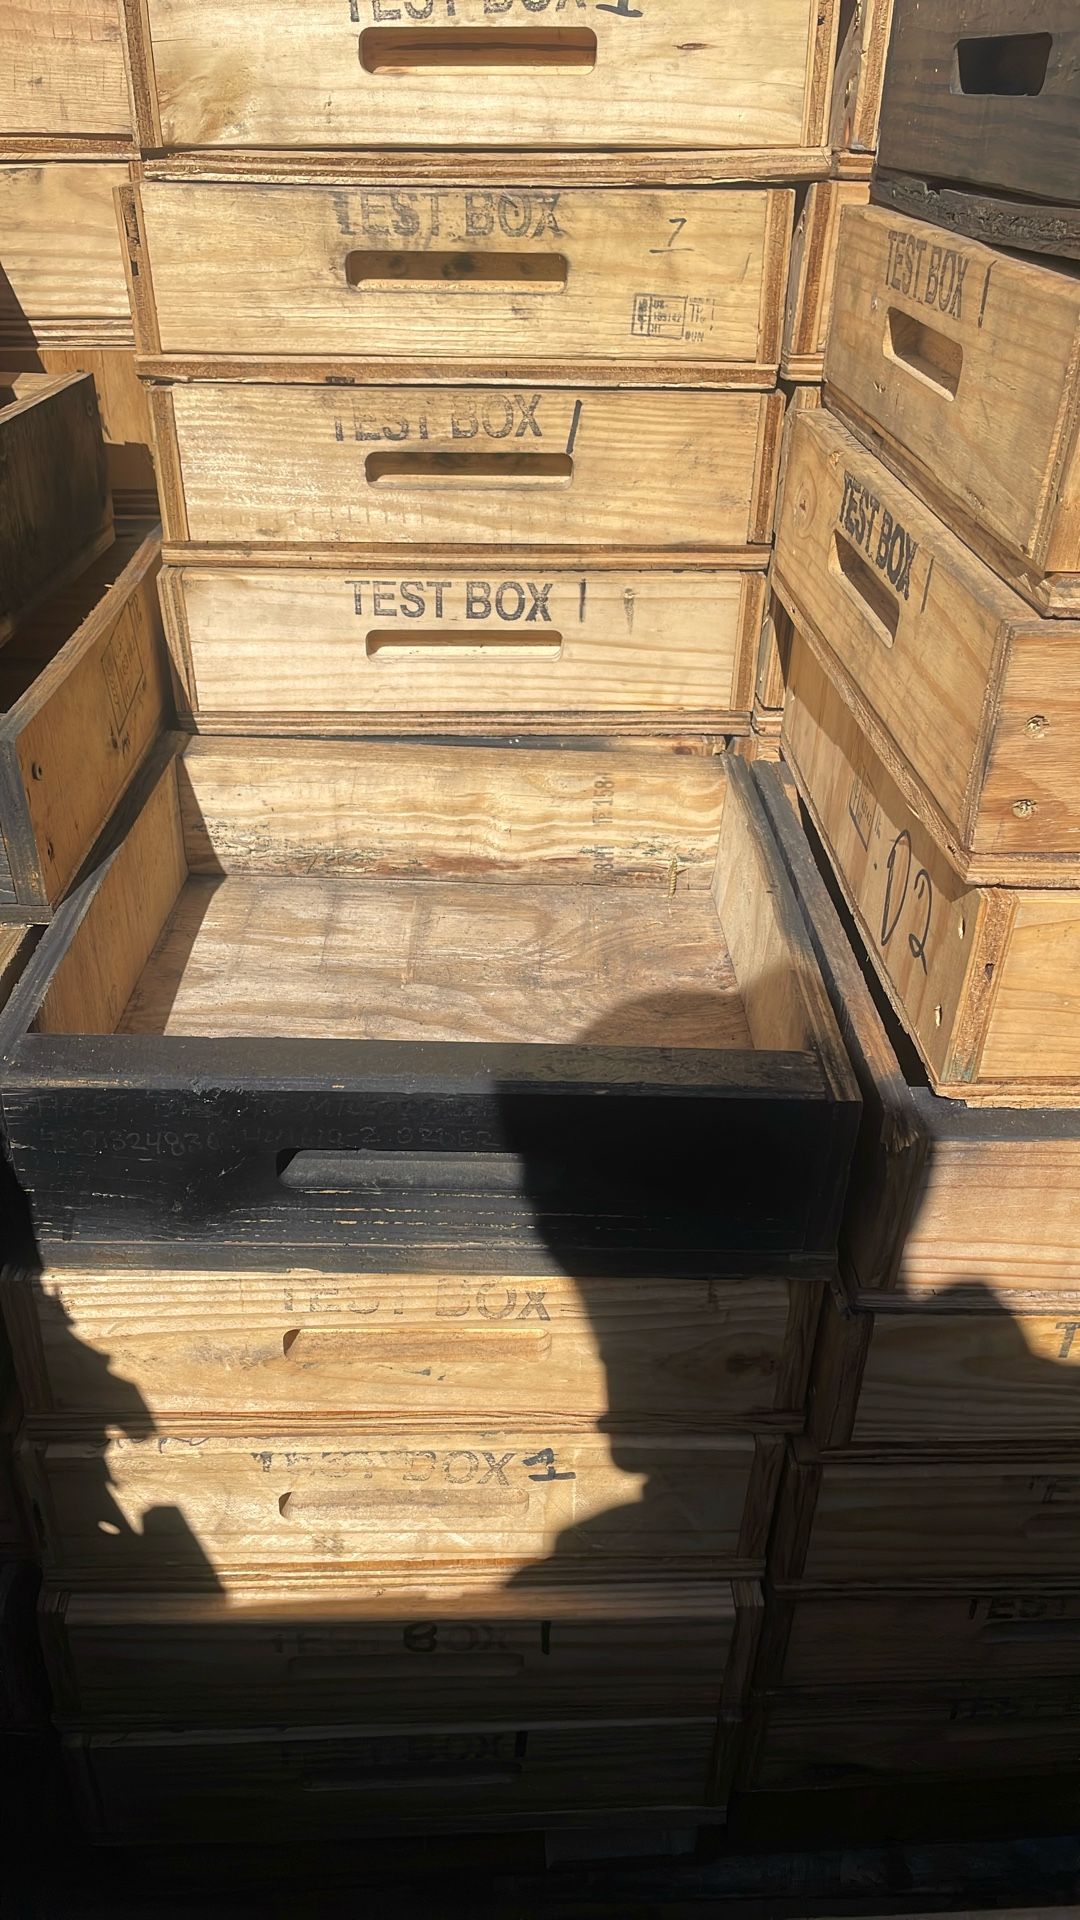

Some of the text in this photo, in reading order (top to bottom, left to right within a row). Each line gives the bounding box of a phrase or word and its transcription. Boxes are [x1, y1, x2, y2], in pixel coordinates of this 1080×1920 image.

[332, 192, 567, 239] TEST BOX
[667, 217, 689, 247] 7
[885, 231, 927, 302] TEST
[925, 246, 970, 320] BOX
[332, 398, 430, 442] TEST
[451, 393, 543, 440] BOX
[839, 468, 881, 562] TEST
[878, 510, 920, 601] BOX
[344, 579, 453, 619] TEST
[465, 580, 554, 622] BOX
[435, 1278, 552, 1321] BOX
[403, 1451, 515, 1486] BOX
[522, 1447, 577, 1482] 1
[403, 1621, 508, 1653] BOX
